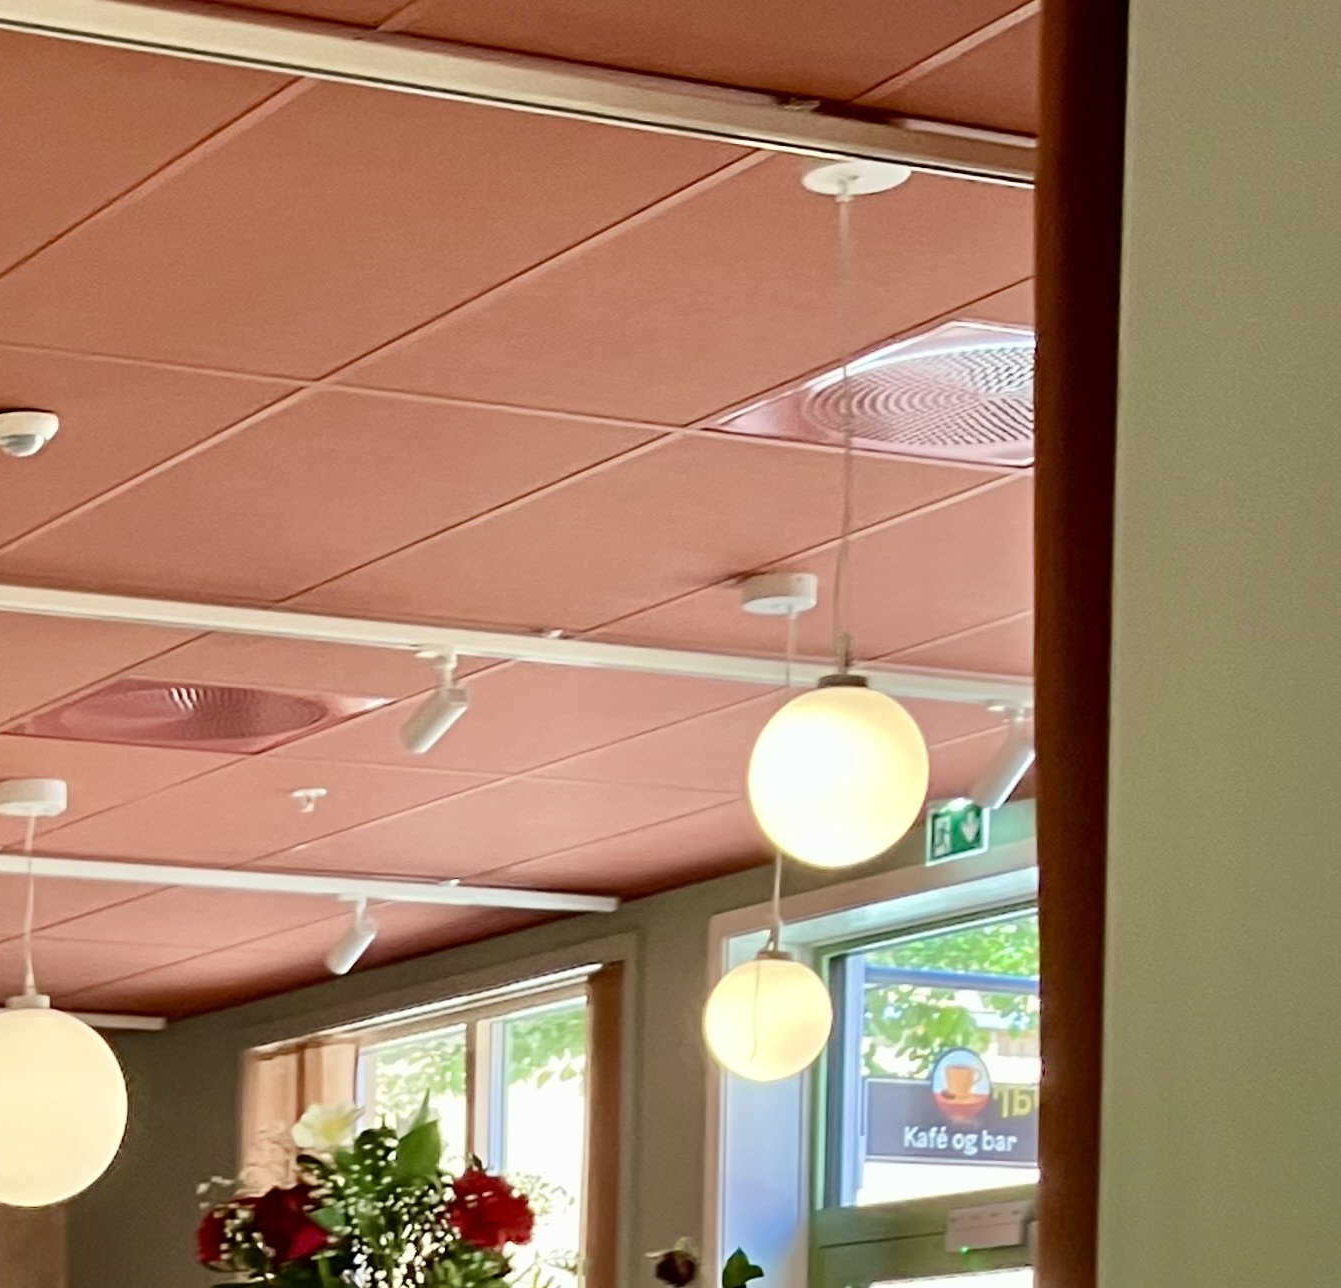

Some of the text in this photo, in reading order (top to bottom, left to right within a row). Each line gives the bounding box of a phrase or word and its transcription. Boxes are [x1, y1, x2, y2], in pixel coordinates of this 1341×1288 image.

[903, 1125, 1017, 1155] Kafé og bar
